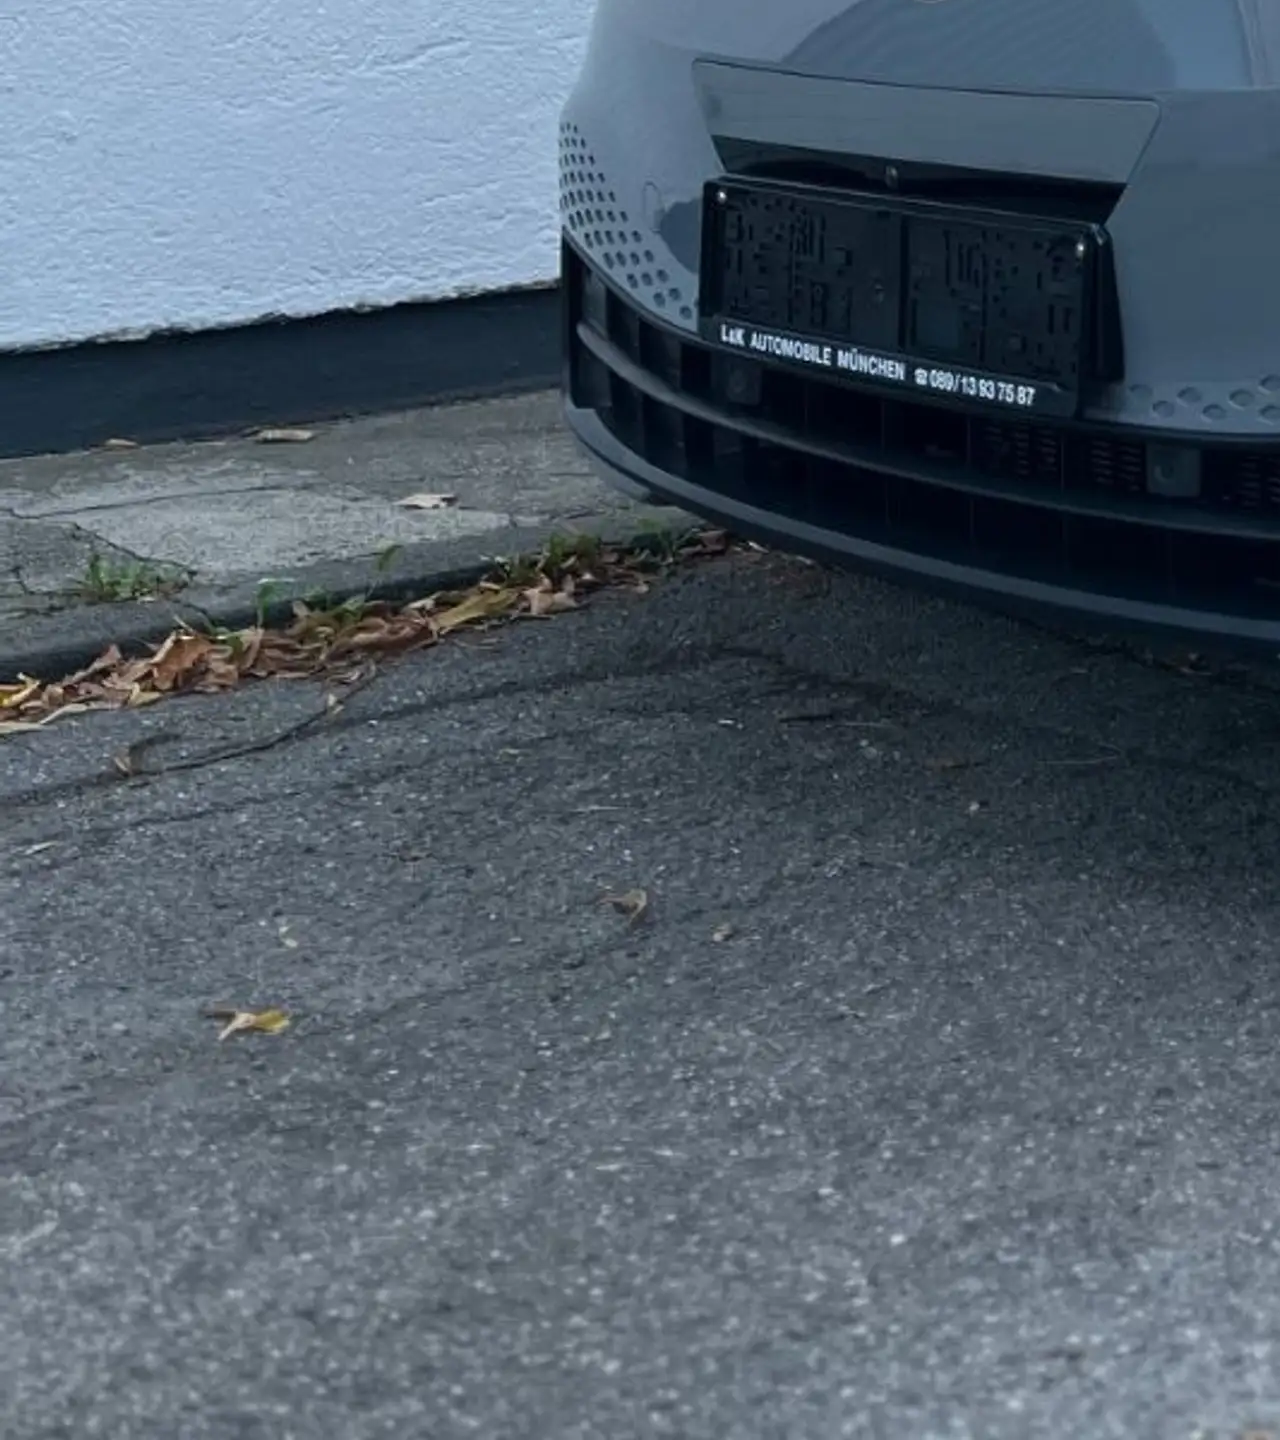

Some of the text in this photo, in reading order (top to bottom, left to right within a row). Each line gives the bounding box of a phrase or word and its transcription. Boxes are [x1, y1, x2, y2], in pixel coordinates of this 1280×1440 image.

[750, 331, 832, 366] AUTOMOBILE
[837, 347, 906, 381] MÜNCHEN
[978, 378, 996, 400] 93
[1016, 385, 1036, 406] 87
